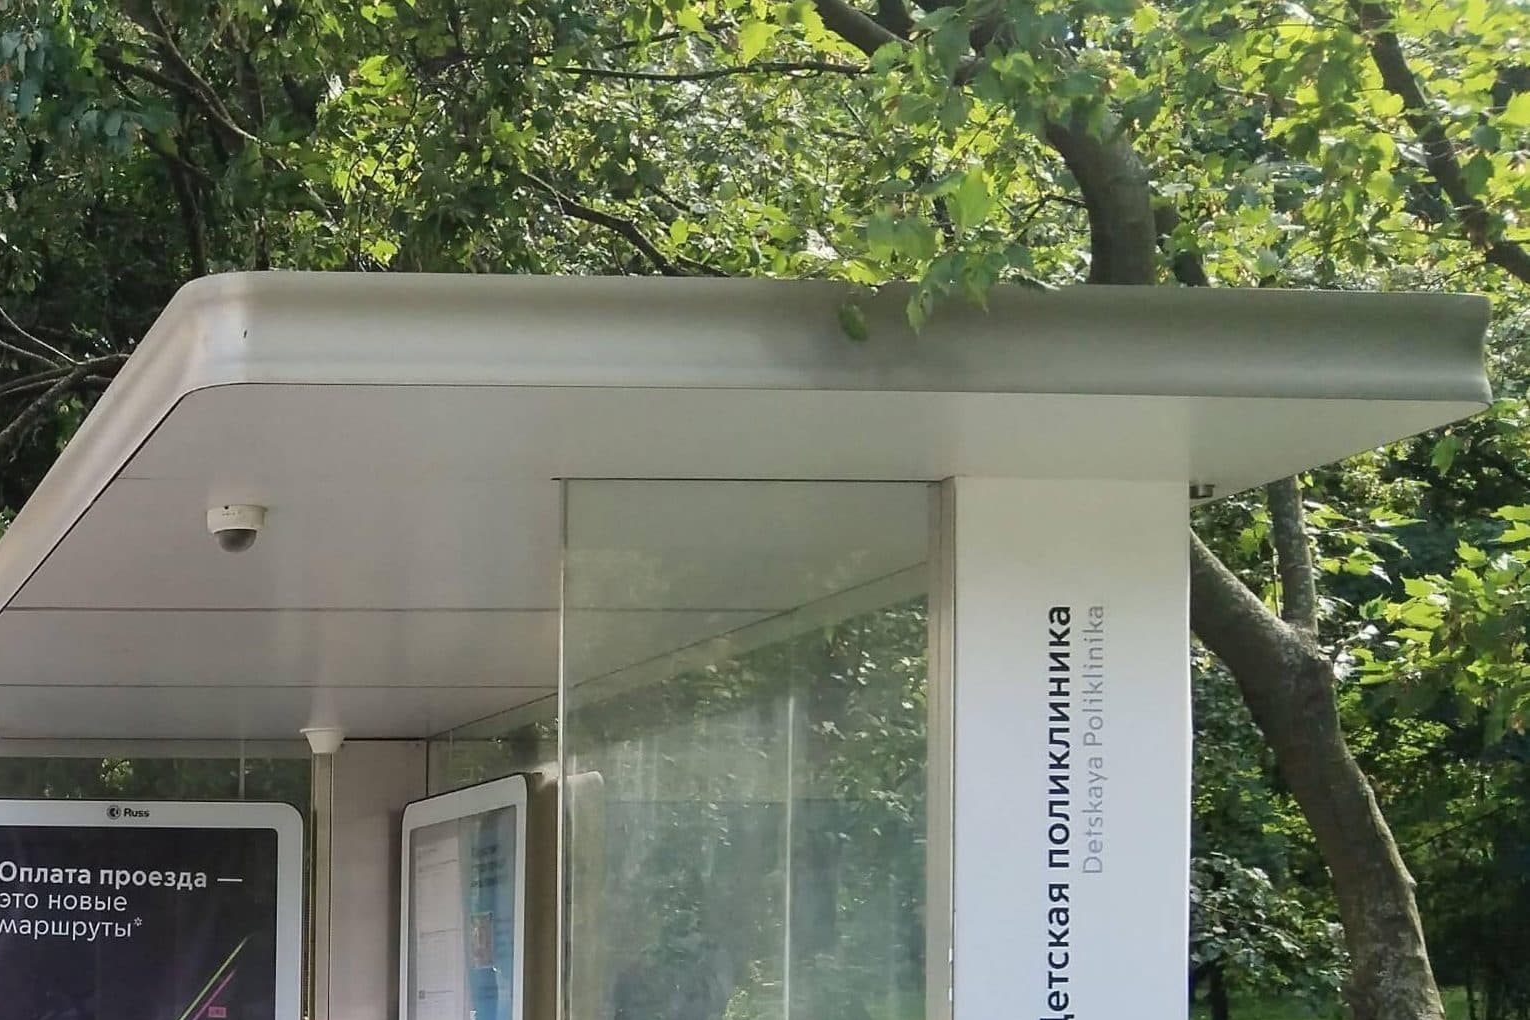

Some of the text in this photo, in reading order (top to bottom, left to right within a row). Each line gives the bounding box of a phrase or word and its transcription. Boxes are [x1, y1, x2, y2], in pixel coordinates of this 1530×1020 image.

[1048, 605, 1071, 868] поликлиника
[1082, 604, 1109, 874] Detskaya Poliklinika
[124, 807, 150, 817] Russ
[99, 869, 207, 891] проезда
[48, 894, 128, 912] новые
